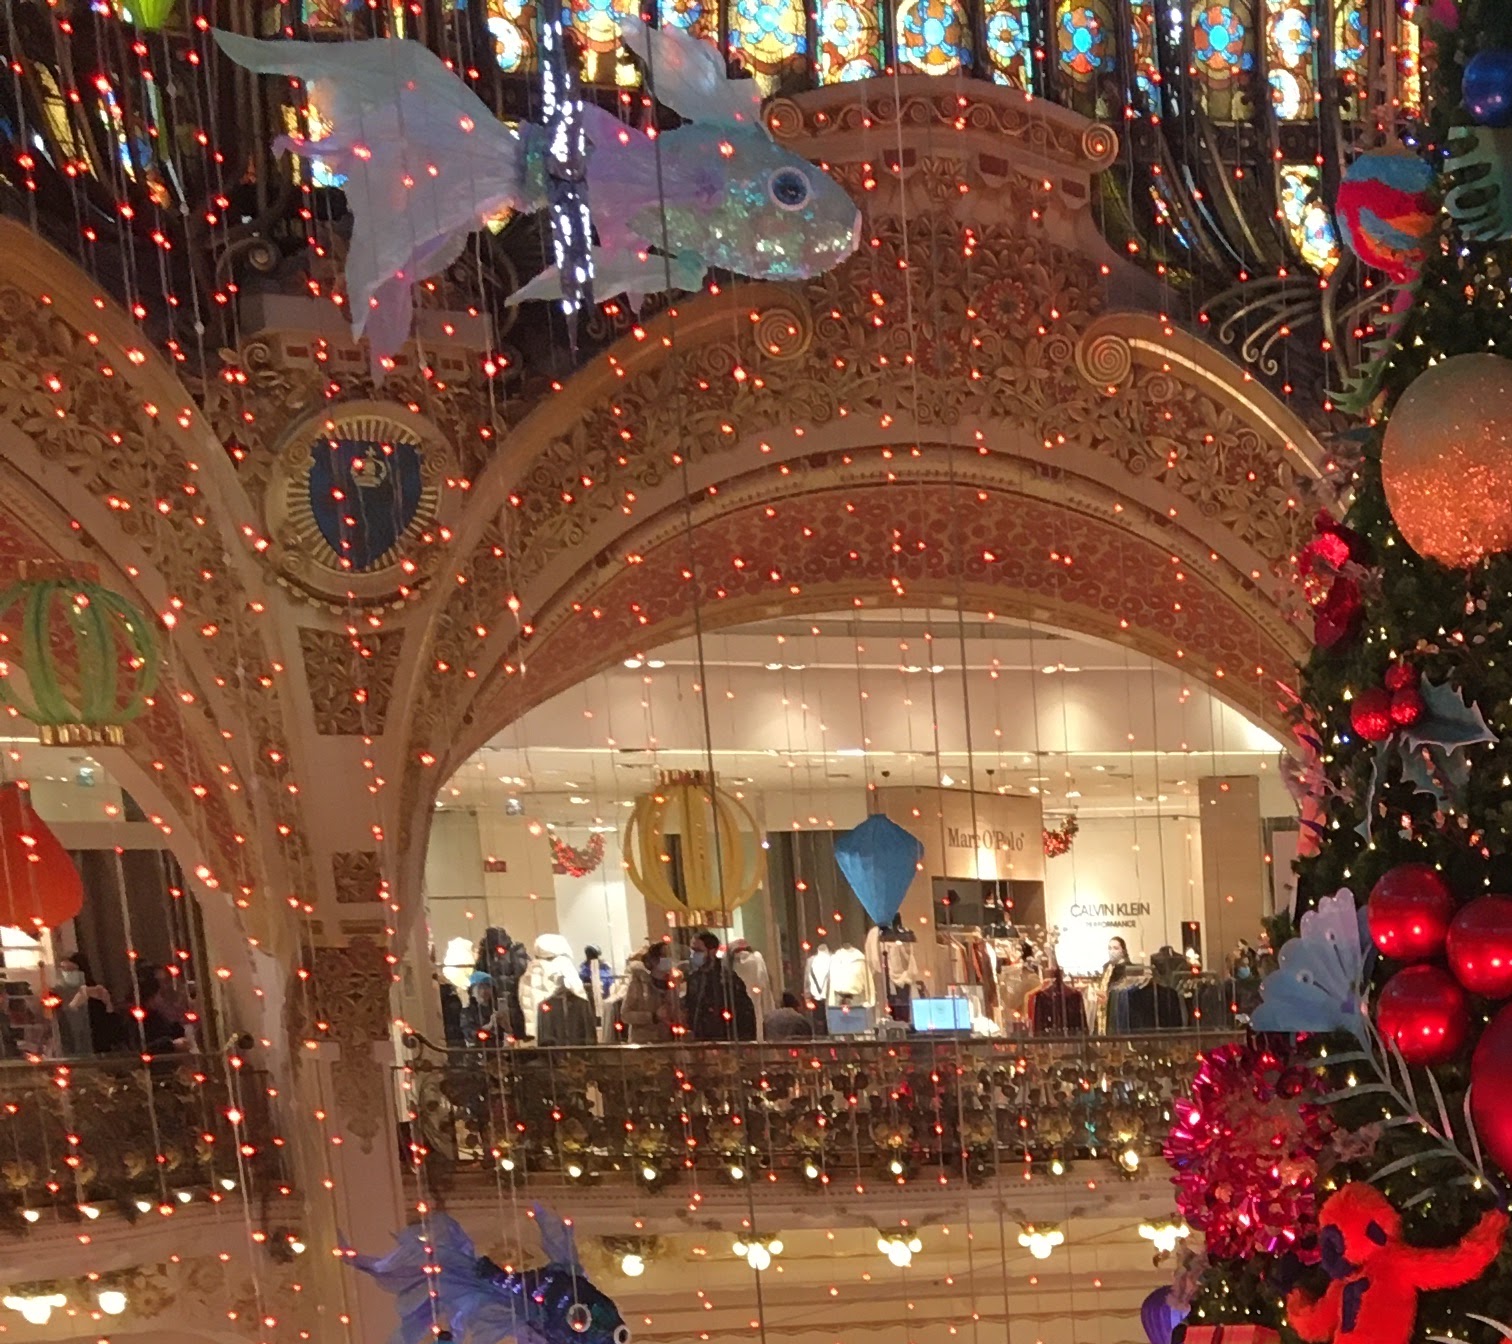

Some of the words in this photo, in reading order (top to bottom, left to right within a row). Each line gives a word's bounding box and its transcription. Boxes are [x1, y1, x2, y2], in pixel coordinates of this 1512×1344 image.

[947, 827, 981, 849] Marc
[1070, 903, 1115, 917] CALVIN
[1116, 902, 1150, 916] KLEIN
